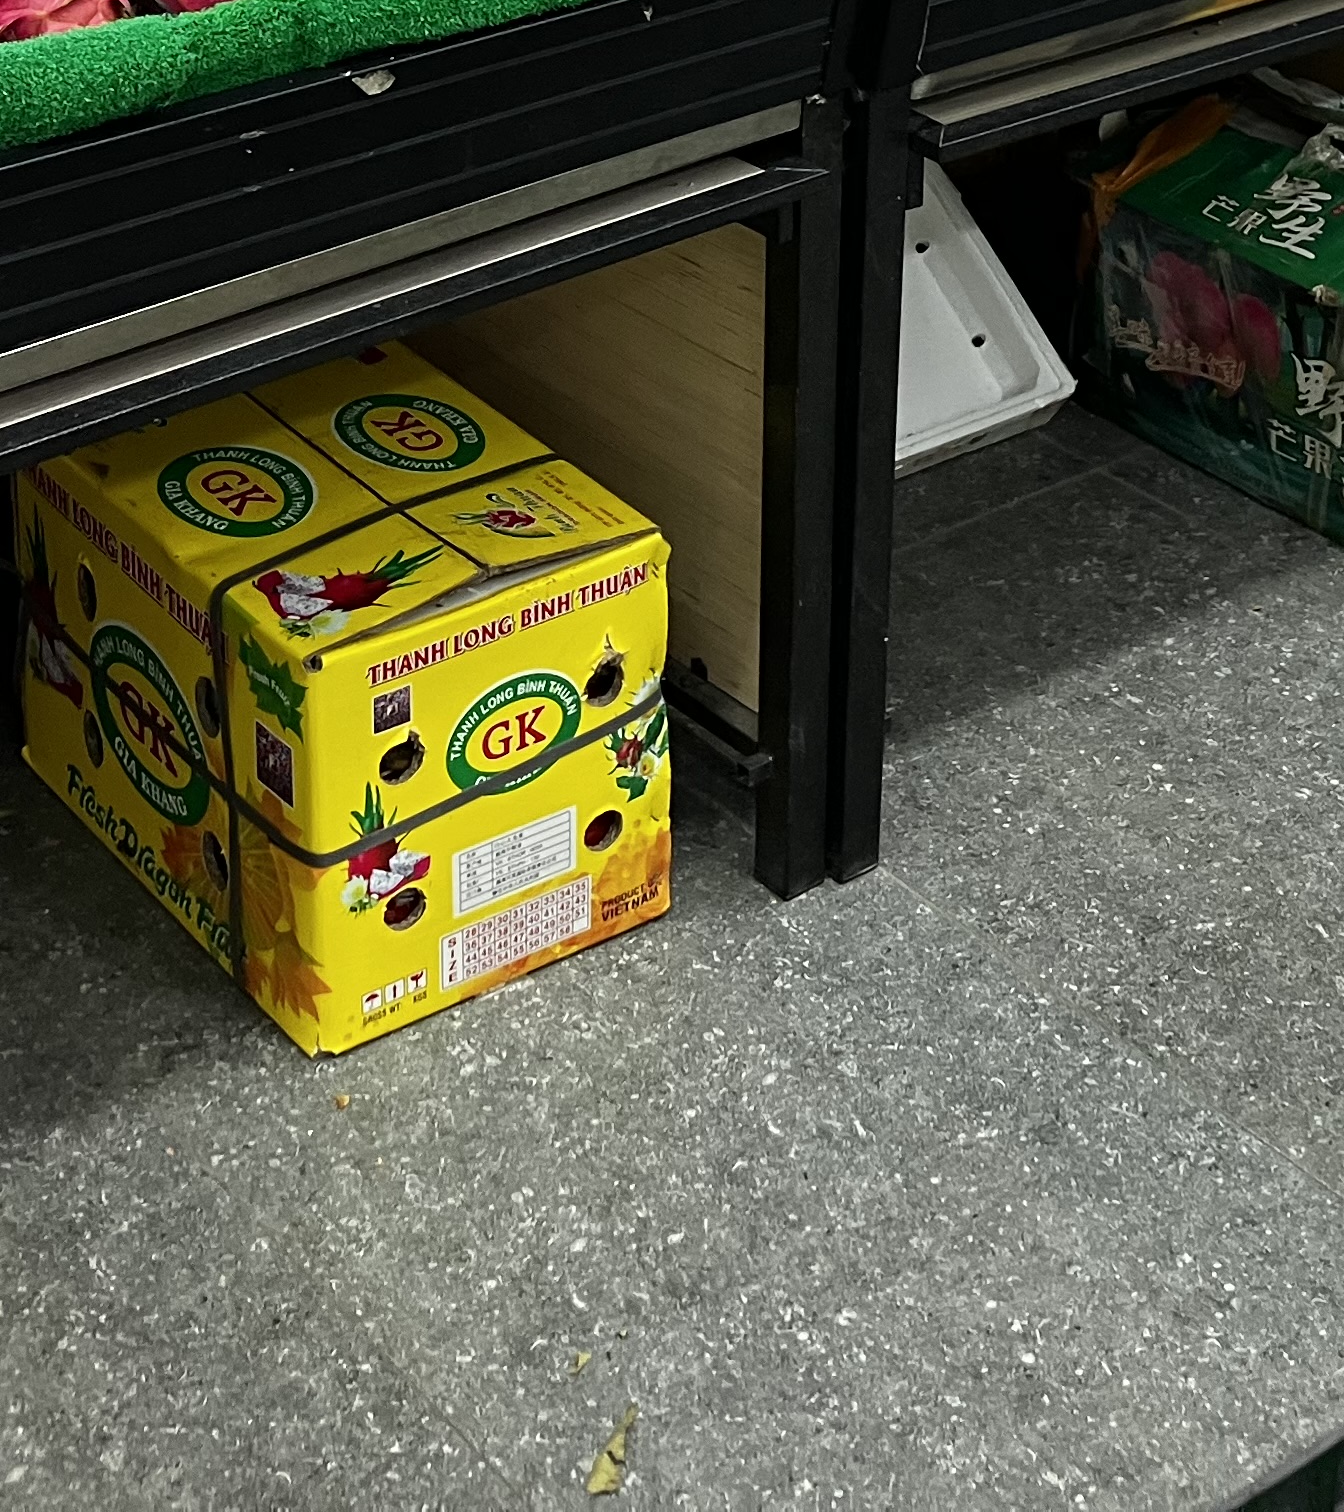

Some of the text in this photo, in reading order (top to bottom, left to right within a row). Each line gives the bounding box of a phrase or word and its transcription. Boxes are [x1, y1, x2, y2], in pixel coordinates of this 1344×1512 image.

[370, 410, 444, 451] GK
[201, 470, 277, 516] GK
[366, 639, 448, 688] THANH
[453, 615, 514, 655] LONG
[520, 591, 573, 630] BÌNH
[450, 711, 480, 761] THANH
[480, 687, 515, 715] LONG
[482, 706, 547, 760] GK
[602, 889, 659, 921] VIETNAM
